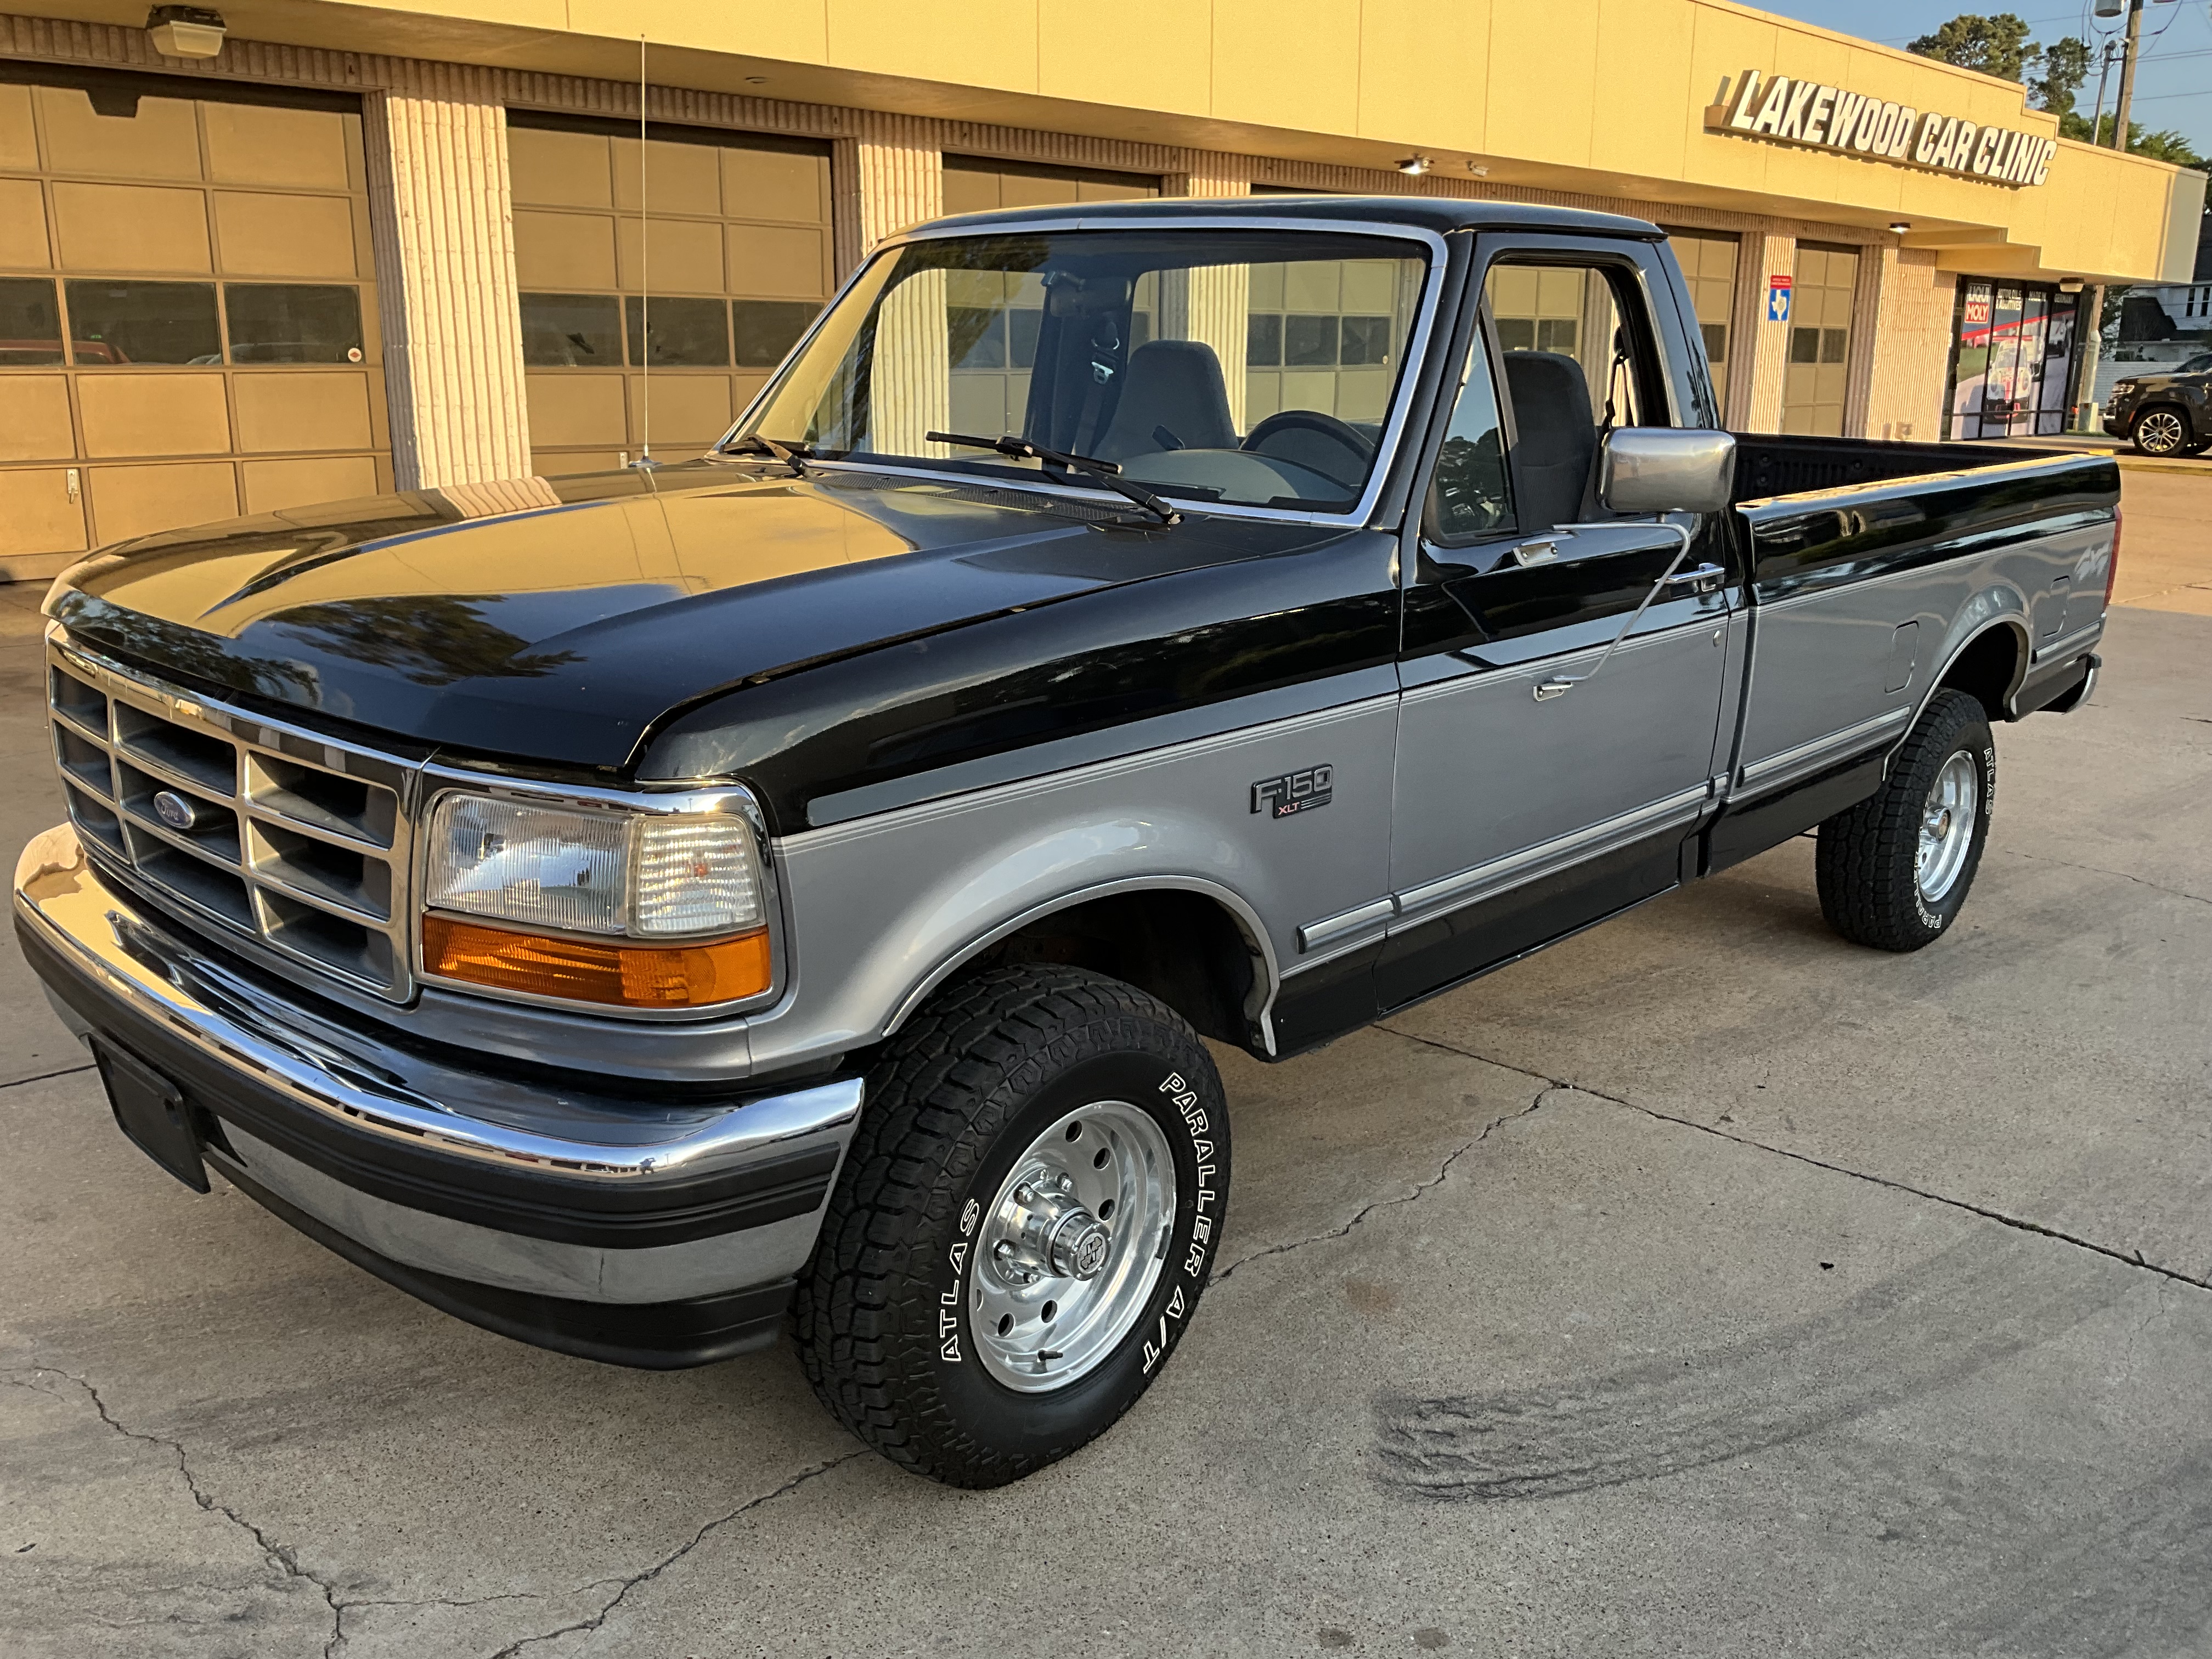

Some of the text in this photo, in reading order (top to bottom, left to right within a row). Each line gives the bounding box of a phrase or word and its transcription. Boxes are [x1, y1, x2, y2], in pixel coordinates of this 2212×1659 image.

[1731, 70, 2057, 186] LAKEWOOD CAR CLINIC
[1966, 304, 1988, 321] MOLY
[1968, 285, 1990, 302] LIQUI
[1984, 747, 1994, 815] ATLAS
[161, 798, 179, 821] Ford
[1278, 802, 1300, 816] XLT
[1143, 1071, 1216, 1374] PARALLER A/T
[940, 1198, 980, 1361] ATLAS
